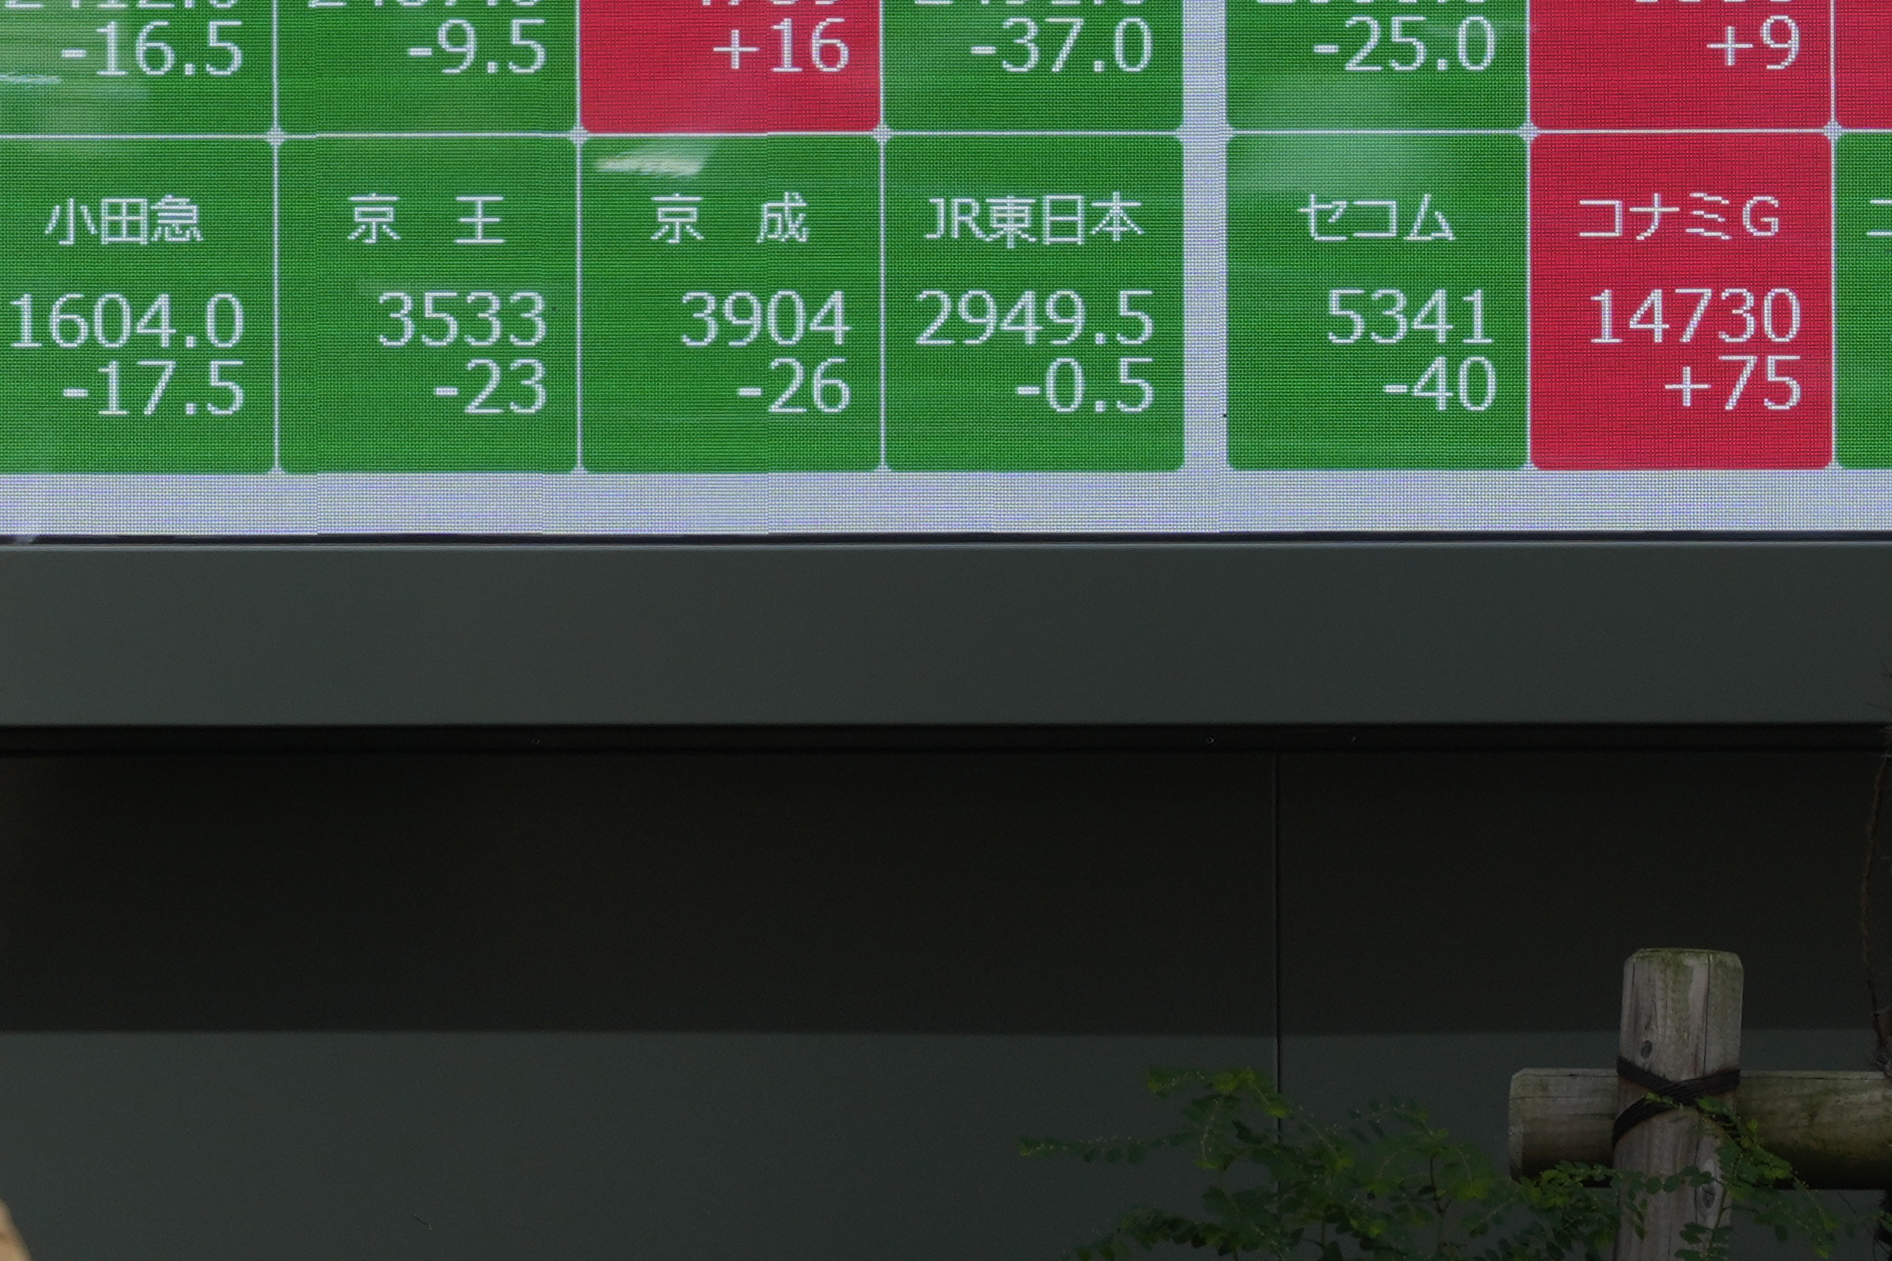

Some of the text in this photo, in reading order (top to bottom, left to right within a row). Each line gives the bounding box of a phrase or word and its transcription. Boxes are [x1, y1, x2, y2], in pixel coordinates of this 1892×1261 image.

[59, 18, 244, 78] -16.5
[405, 16, 548, 76] -9.5
[711, 15, 851, 75] +16
[968, 14, 1154, 75] -37.0
[1312, 13, 1499, 73] -25.0
[43, 192, 204, 248] 小田急
[923, 190, 1143, 250] JR東日本
[1299, 192, 1456, 243] セコム
[1577, 189, 1781, 243] コナミG
[10, 291, 246, 350] 1604.0
[376, 288, 548, 349] 3533
[679, 288, 852, 349] 3904
[913, 288, 1155, 348] 2949.5
[1325, 286, 1494, 347] 5341
[1589, 285, 1803, 346] 14730
[60, 358, 246, 418] -17.5
[431, 356, 548, 417] -23
[735, 355, 853, 416] -26
[1381, 354, 1499, 413] -40
[1662, 352, 1803, 413] +75
